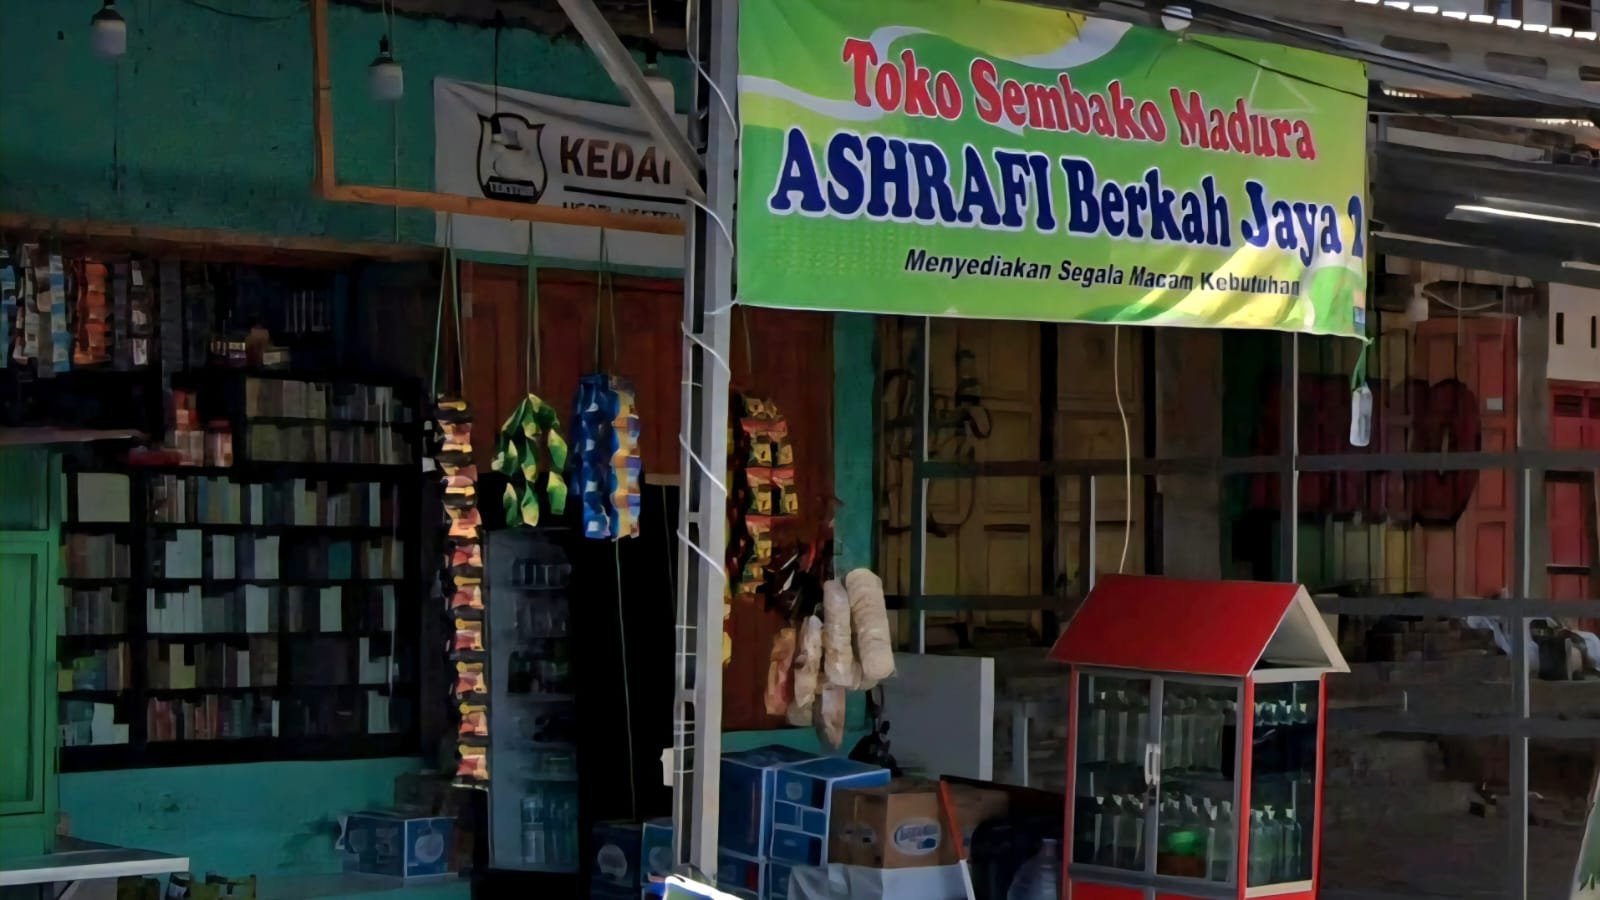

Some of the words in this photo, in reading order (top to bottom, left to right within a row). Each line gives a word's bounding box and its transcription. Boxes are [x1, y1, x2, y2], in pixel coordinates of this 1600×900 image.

[843, 37, 963, 120] Toko
[970, 58, 1166, 142] Sembako
[1170, 88, 1316, 160] Madura
[560, 135, 671, 185] KEDAI
[769, 127, 1057, 232] ASHRAFI
[1060, 157, 1231, 248] Berkah
[1241, 180, 1342, 266] Jaya
[904, 248, 1052, 281] Menyediakan
[1058, 260, 1124, 287] Segala
[1129, 265, 1194, 291] Macam
[1200, 272, 1300, 297] Kebutuhan
